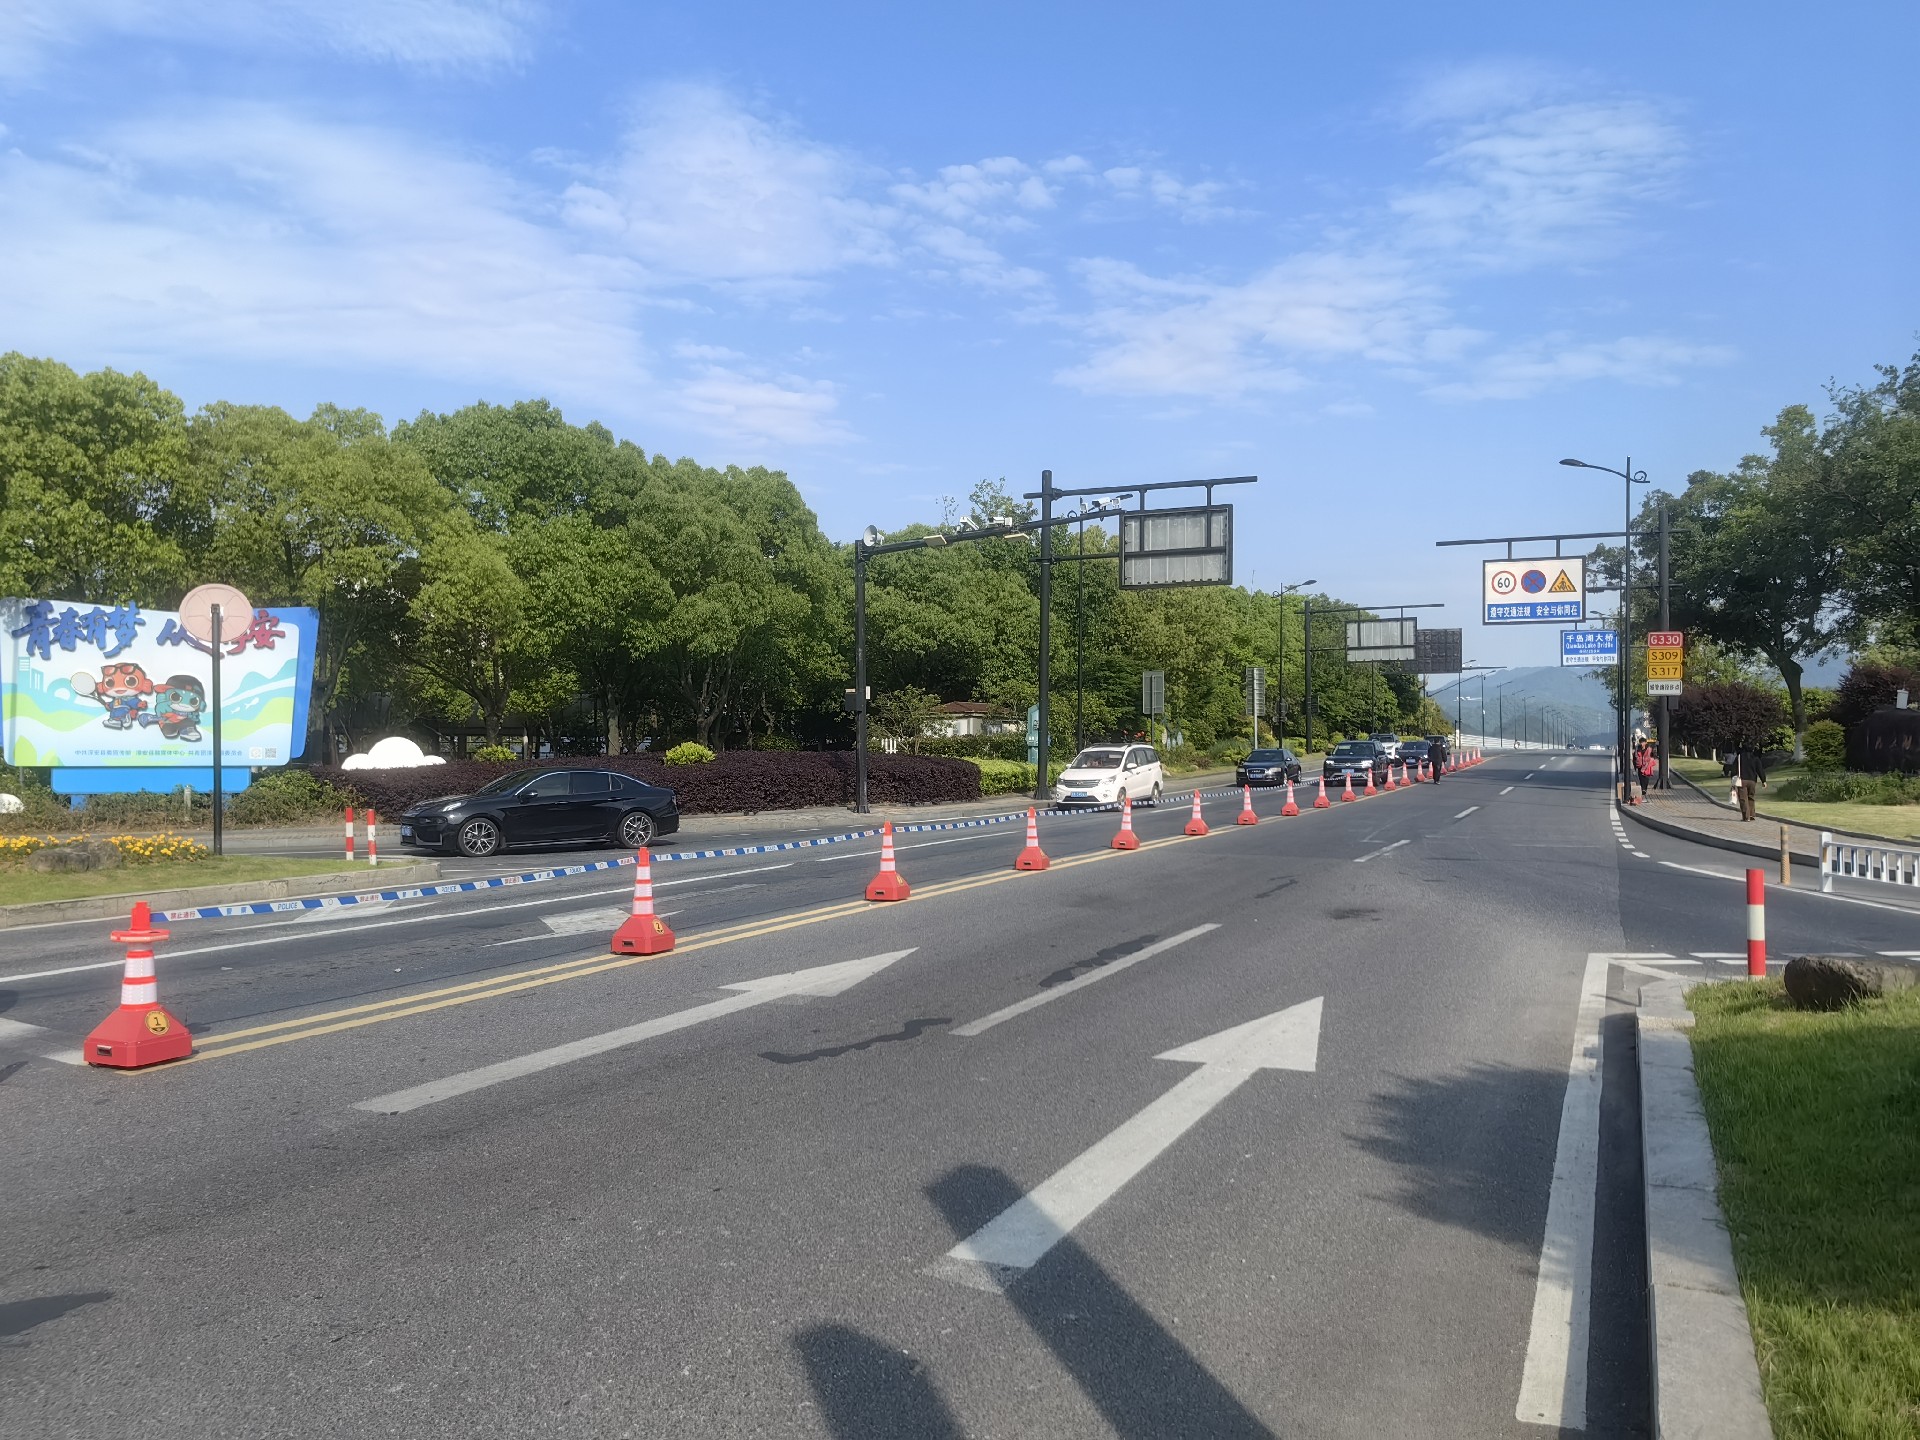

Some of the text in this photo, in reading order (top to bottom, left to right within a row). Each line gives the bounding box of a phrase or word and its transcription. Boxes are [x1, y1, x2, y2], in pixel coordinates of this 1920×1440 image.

[1497, 577, 1511, 588] 60
[1490, 604, 1578, 618] 遵守交通法规 安全与你同在
[12, 600, 286, 660] 青春有梦 从安
[1566, 633, 1614, 643] 千岛湖大桥
[1650, 635, 1680, 645] G330
[1651, 651, 1679, 661] S309
[1651, 667, 1678, 676] S317
[277, 902, 298, 910] POLICE
[170, 910, 196, 920] 禁止通行
[154, 1016, 161, 1026] 1
